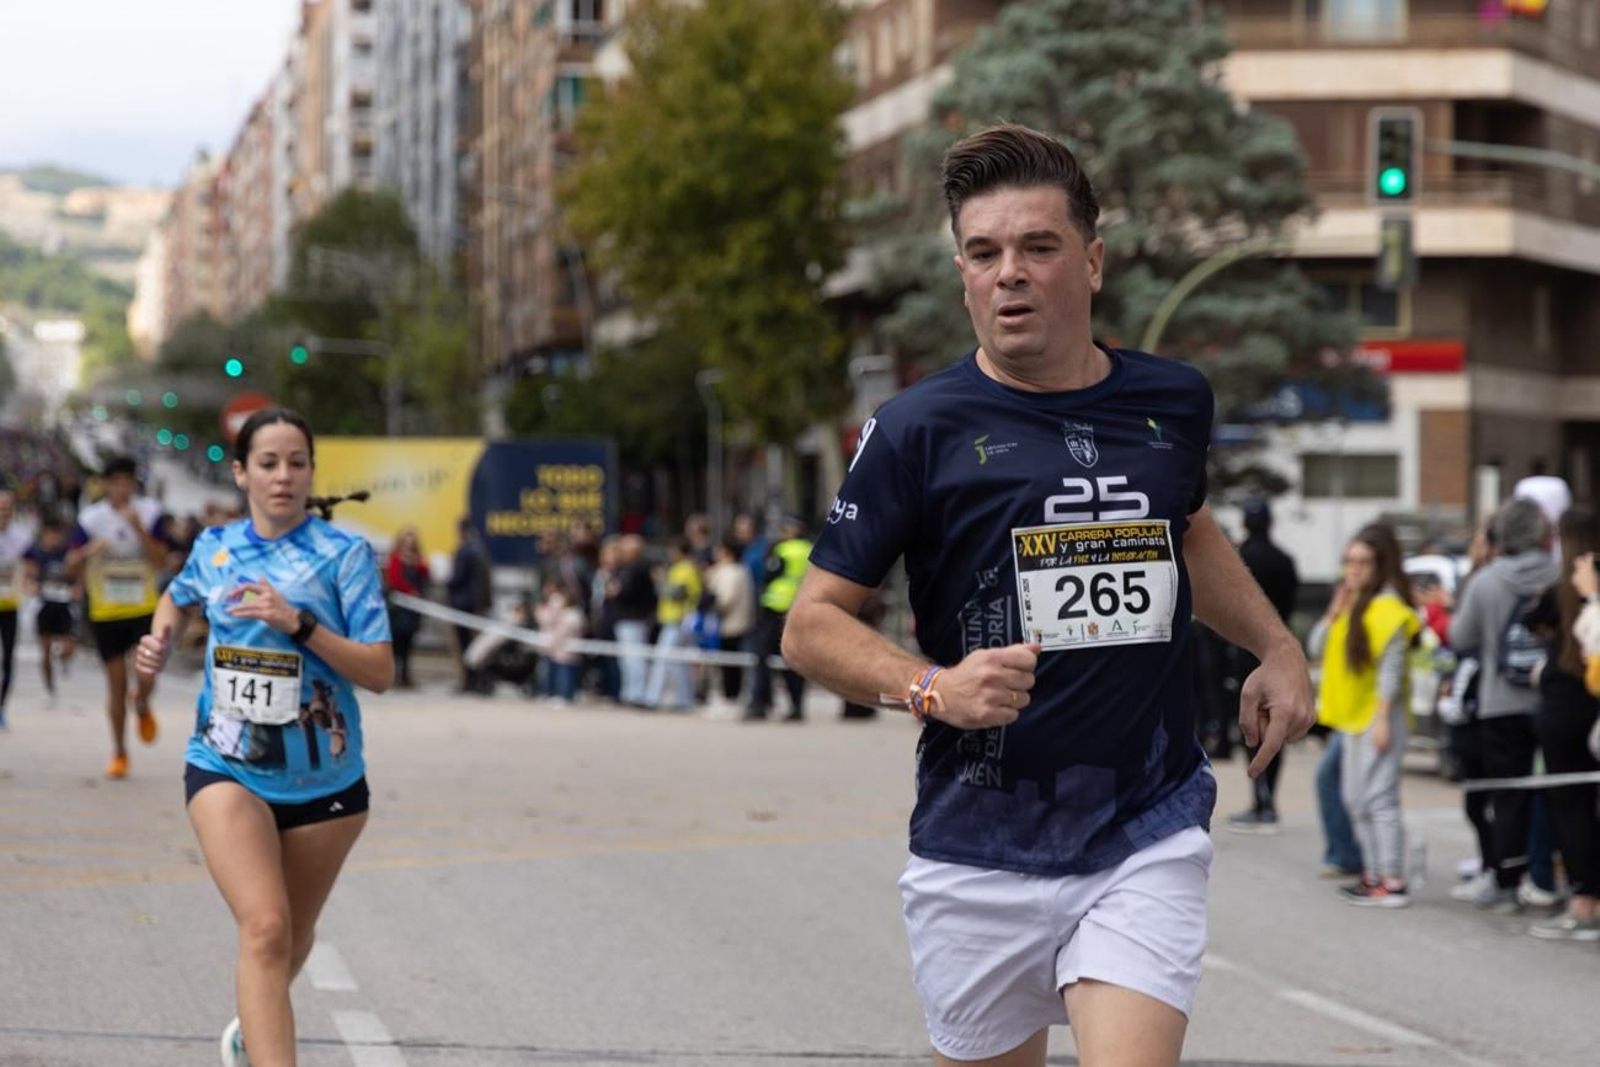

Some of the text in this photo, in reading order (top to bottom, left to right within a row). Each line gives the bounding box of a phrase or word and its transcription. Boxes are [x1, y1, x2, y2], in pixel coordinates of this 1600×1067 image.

[1044, 475, 1149, 523] 25
[1021, 527, 1163, 557] XXV CARRERA POPULAR
[1060, 536, 1166, 554] y gran caminata
[1055, 571, 1150, 620] 265
[228, 677, 273, 706] 141
